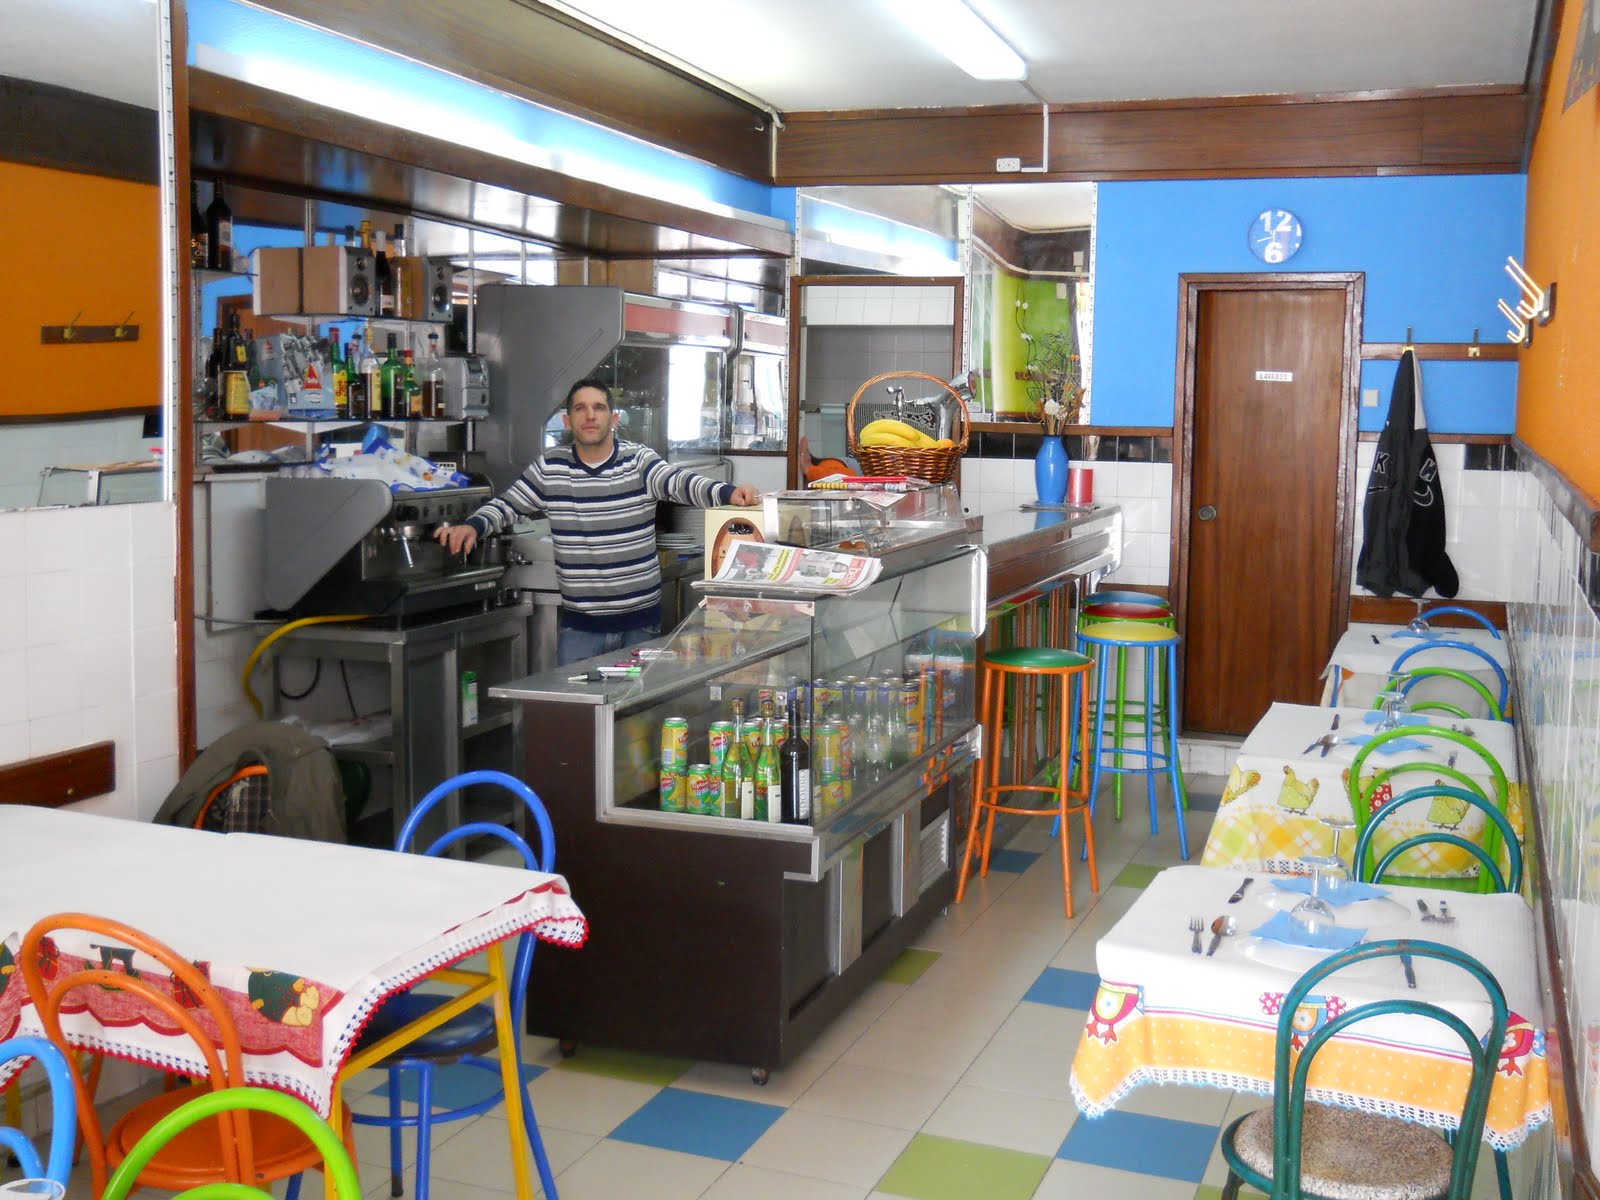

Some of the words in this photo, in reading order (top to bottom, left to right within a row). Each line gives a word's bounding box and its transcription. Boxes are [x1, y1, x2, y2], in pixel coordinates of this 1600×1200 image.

[1260, 210, 1292, 232] 12
[1264, 241, 1283, 264] 6
[1259, 372, 1289, 381] LAVABOS
